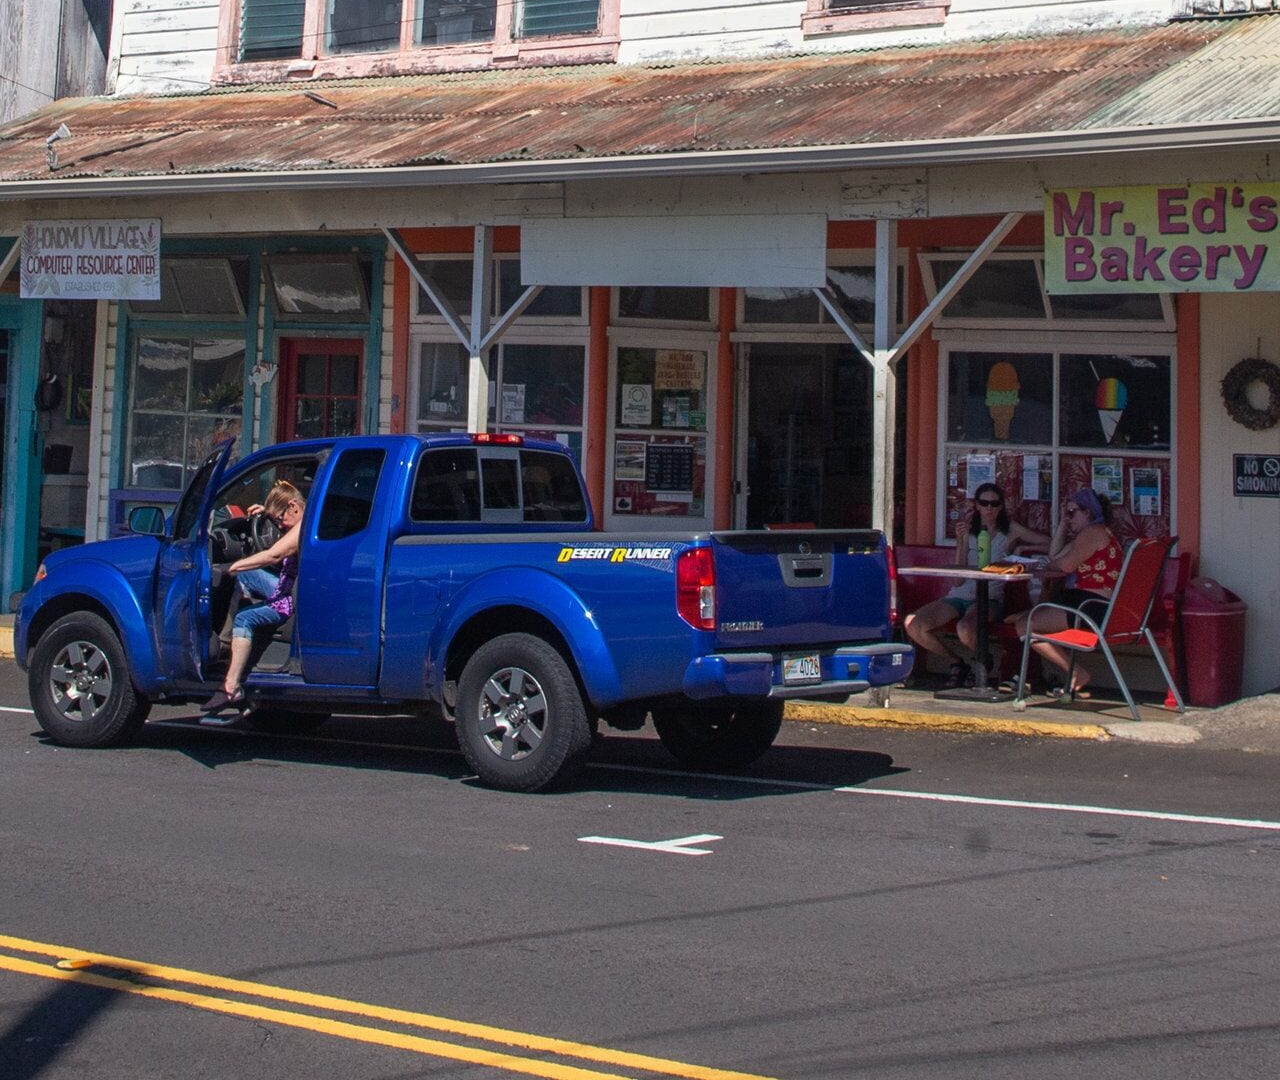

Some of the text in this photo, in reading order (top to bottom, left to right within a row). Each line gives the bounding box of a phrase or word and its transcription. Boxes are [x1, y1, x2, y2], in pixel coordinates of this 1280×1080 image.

[1053, 186, 1279, 236] Mr. Ed's
[87, 224, 140, 249] VILLAGE
[27, 255, 155, 275] COMPUTER RESOURCE CENTER
[1064, 236, 1268, 290] Bakery
[1243, 460, 1259, 474] NO
[557, 548, 672, 562] DESERT RUNNER
